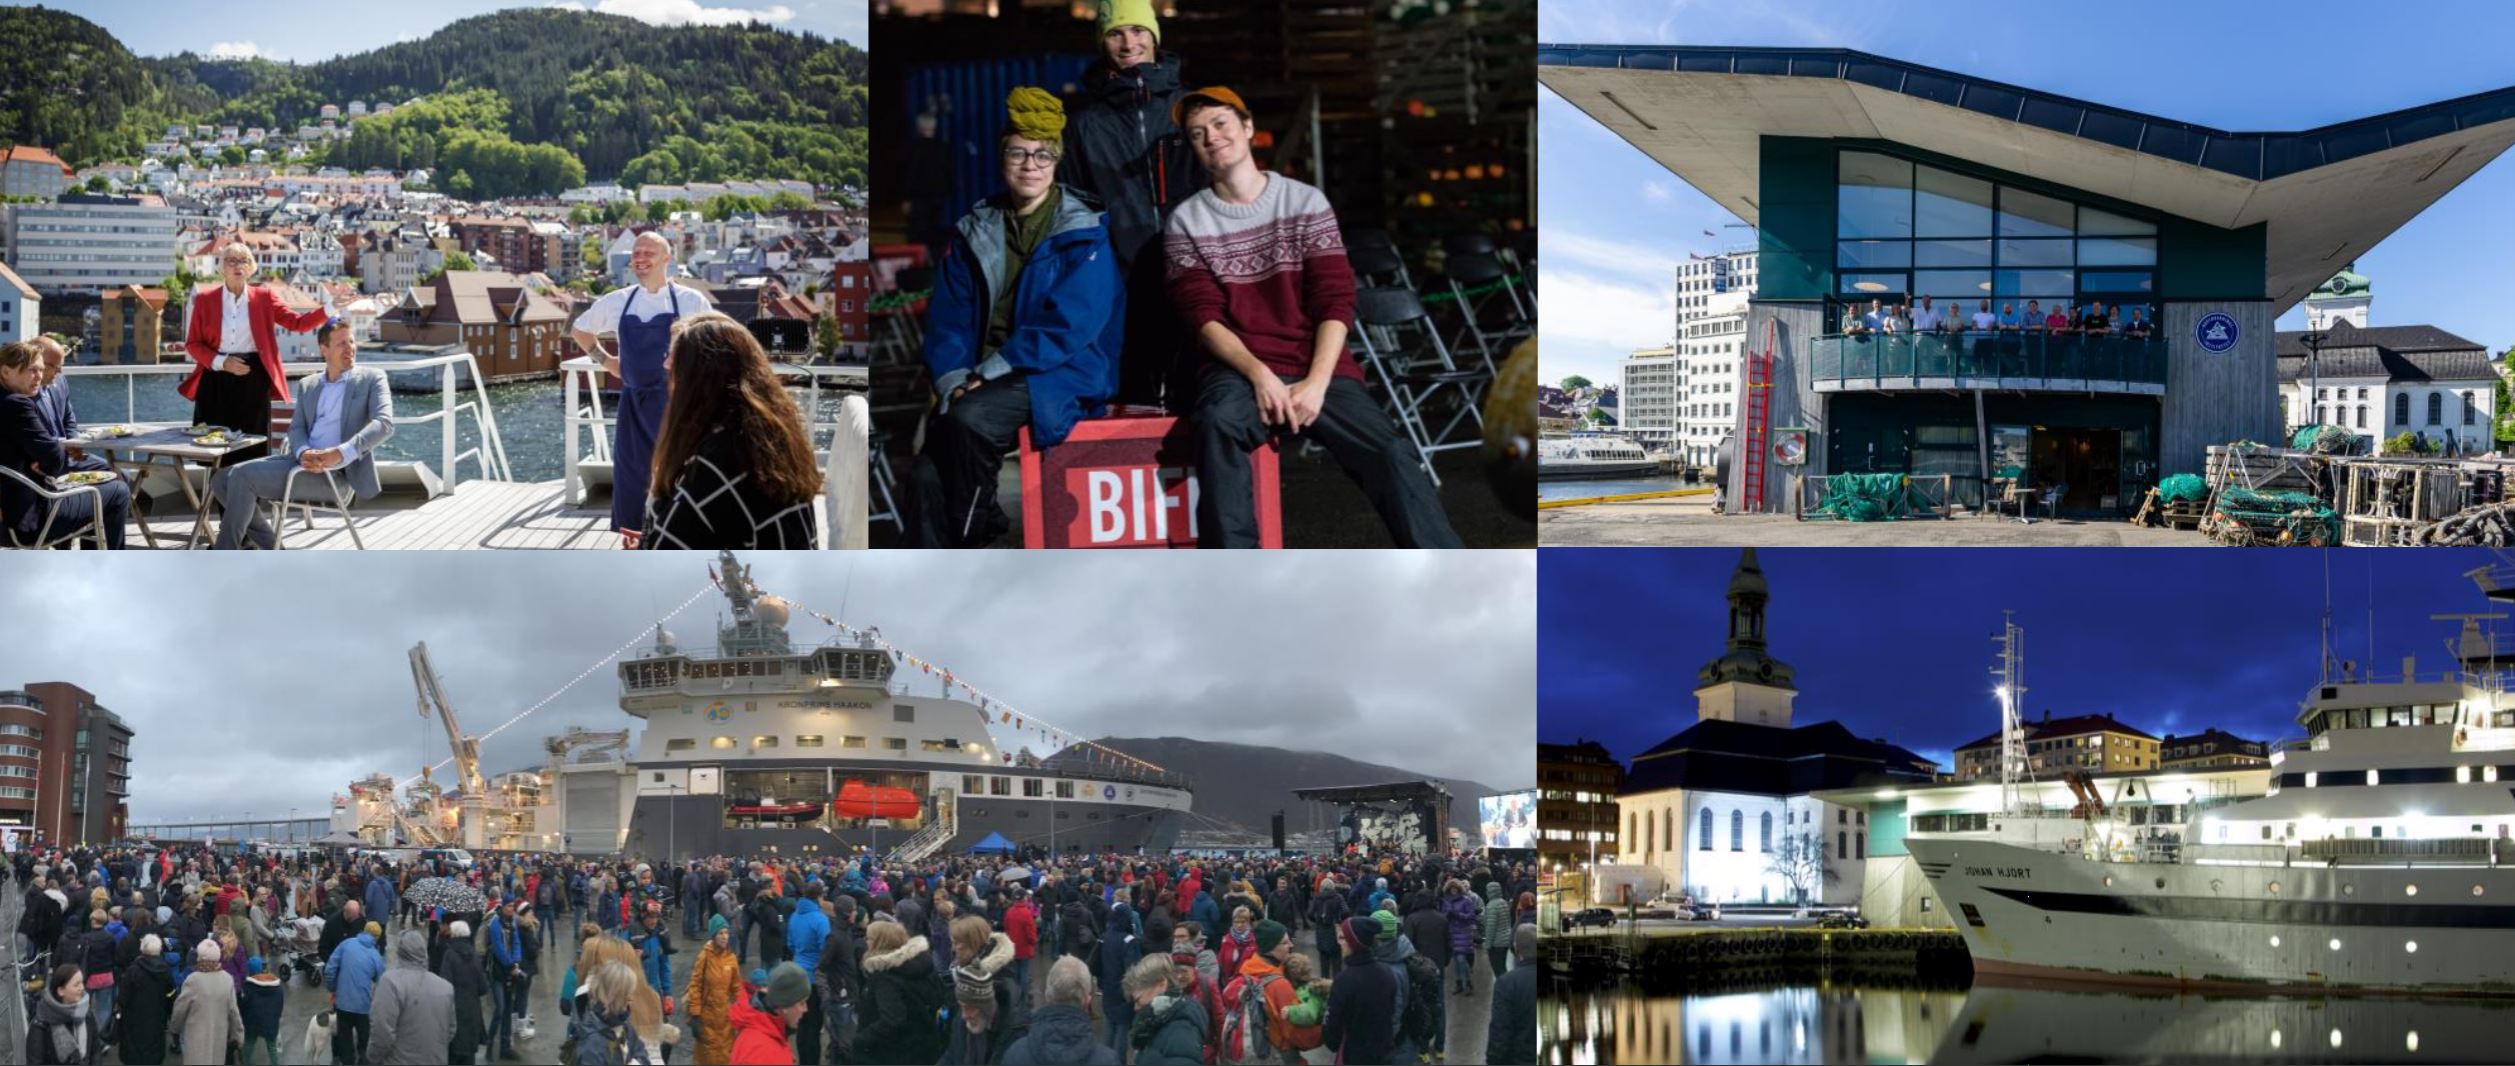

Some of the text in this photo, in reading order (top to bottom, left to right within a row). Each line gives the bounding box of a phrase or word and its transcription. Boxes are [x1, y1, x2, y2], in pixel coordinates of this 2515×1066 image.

[833, 700, 873, 709] HAAKON
[1964, 865, 2031, 879] JOHAN HJORT
